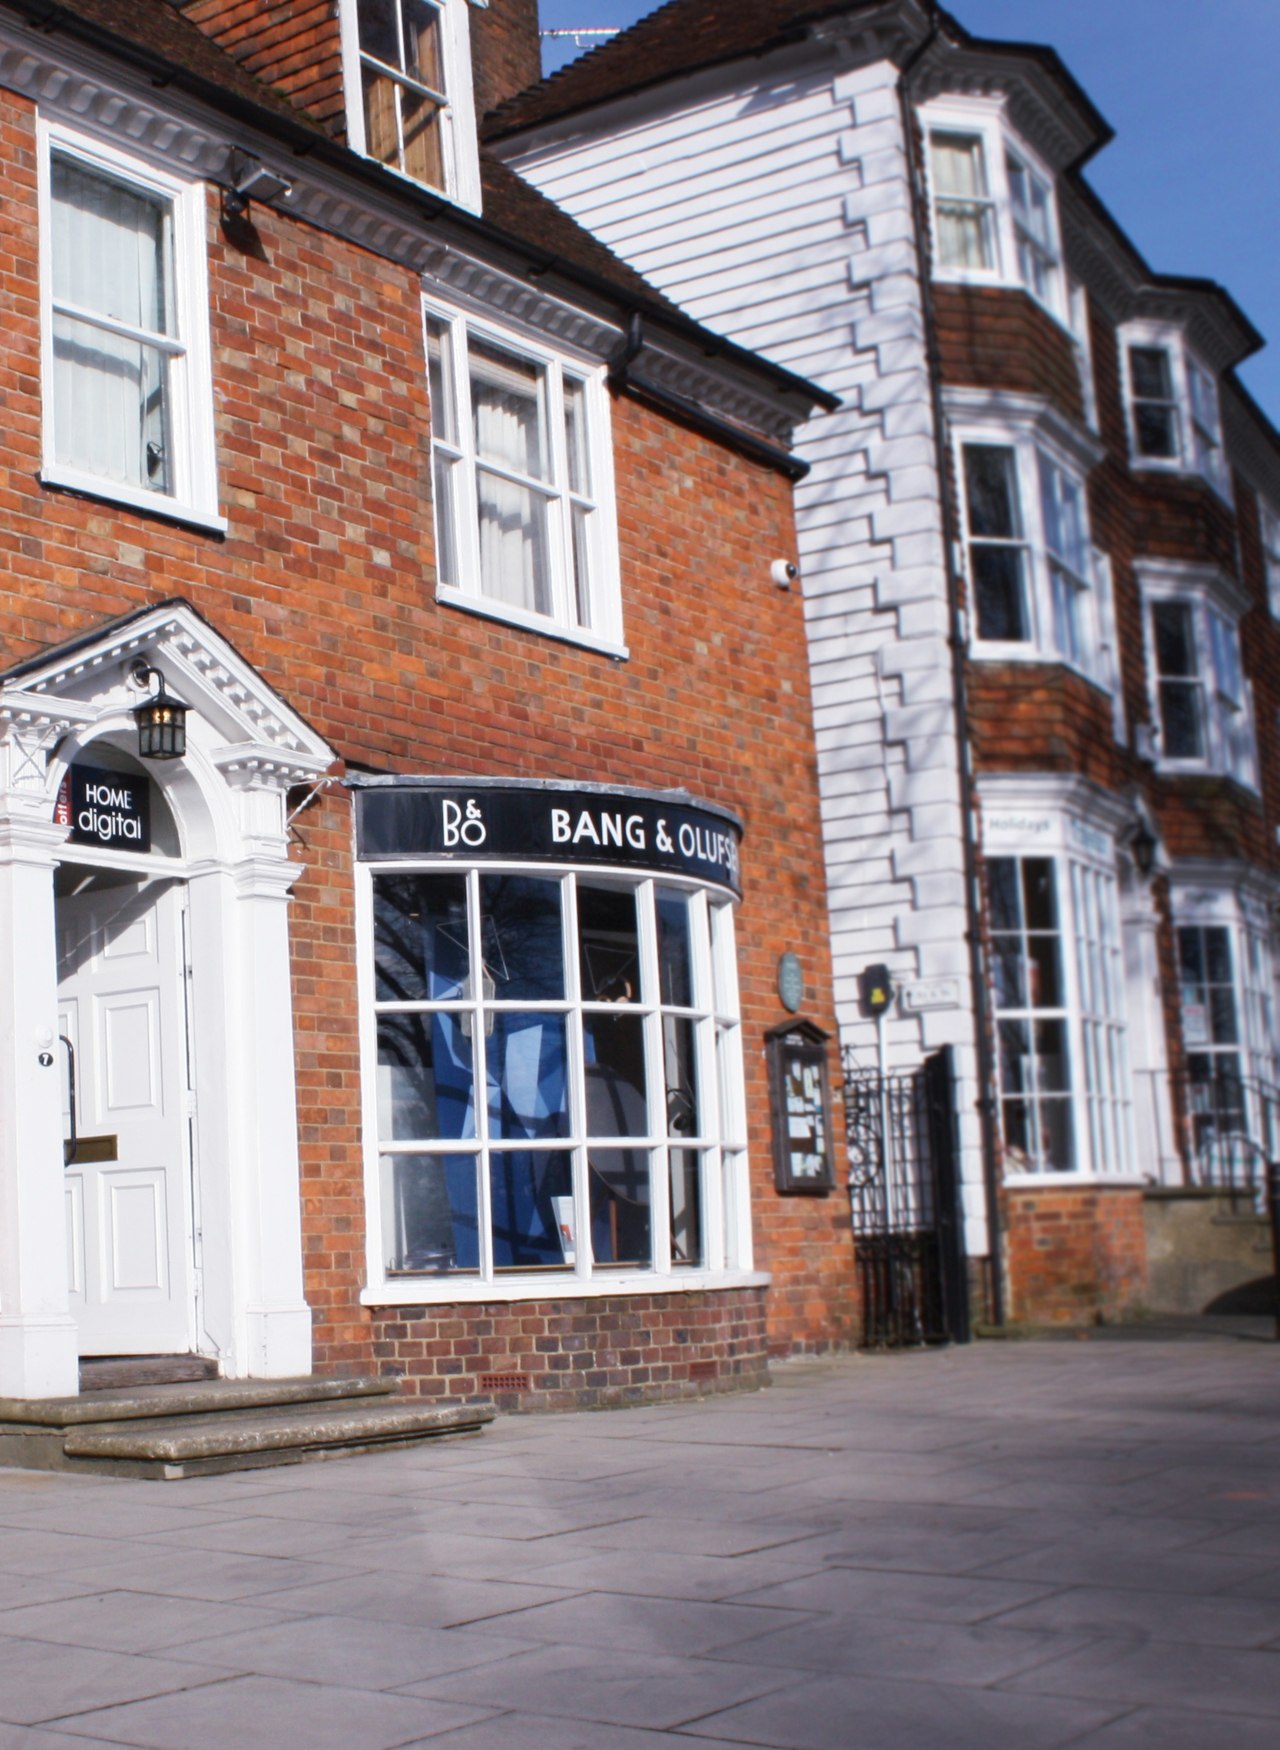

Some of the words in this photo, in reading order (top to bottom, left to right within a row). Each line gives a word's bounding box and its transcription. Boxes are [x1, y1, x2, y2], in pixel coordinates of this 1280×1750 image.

[57, 781, 68, 825] otters
[86, 783, 132, 809] HOME
[78, 808, 142, 840] digital
[551, 808, 646, 850] BANG
[655, 818, 675, 854] &
